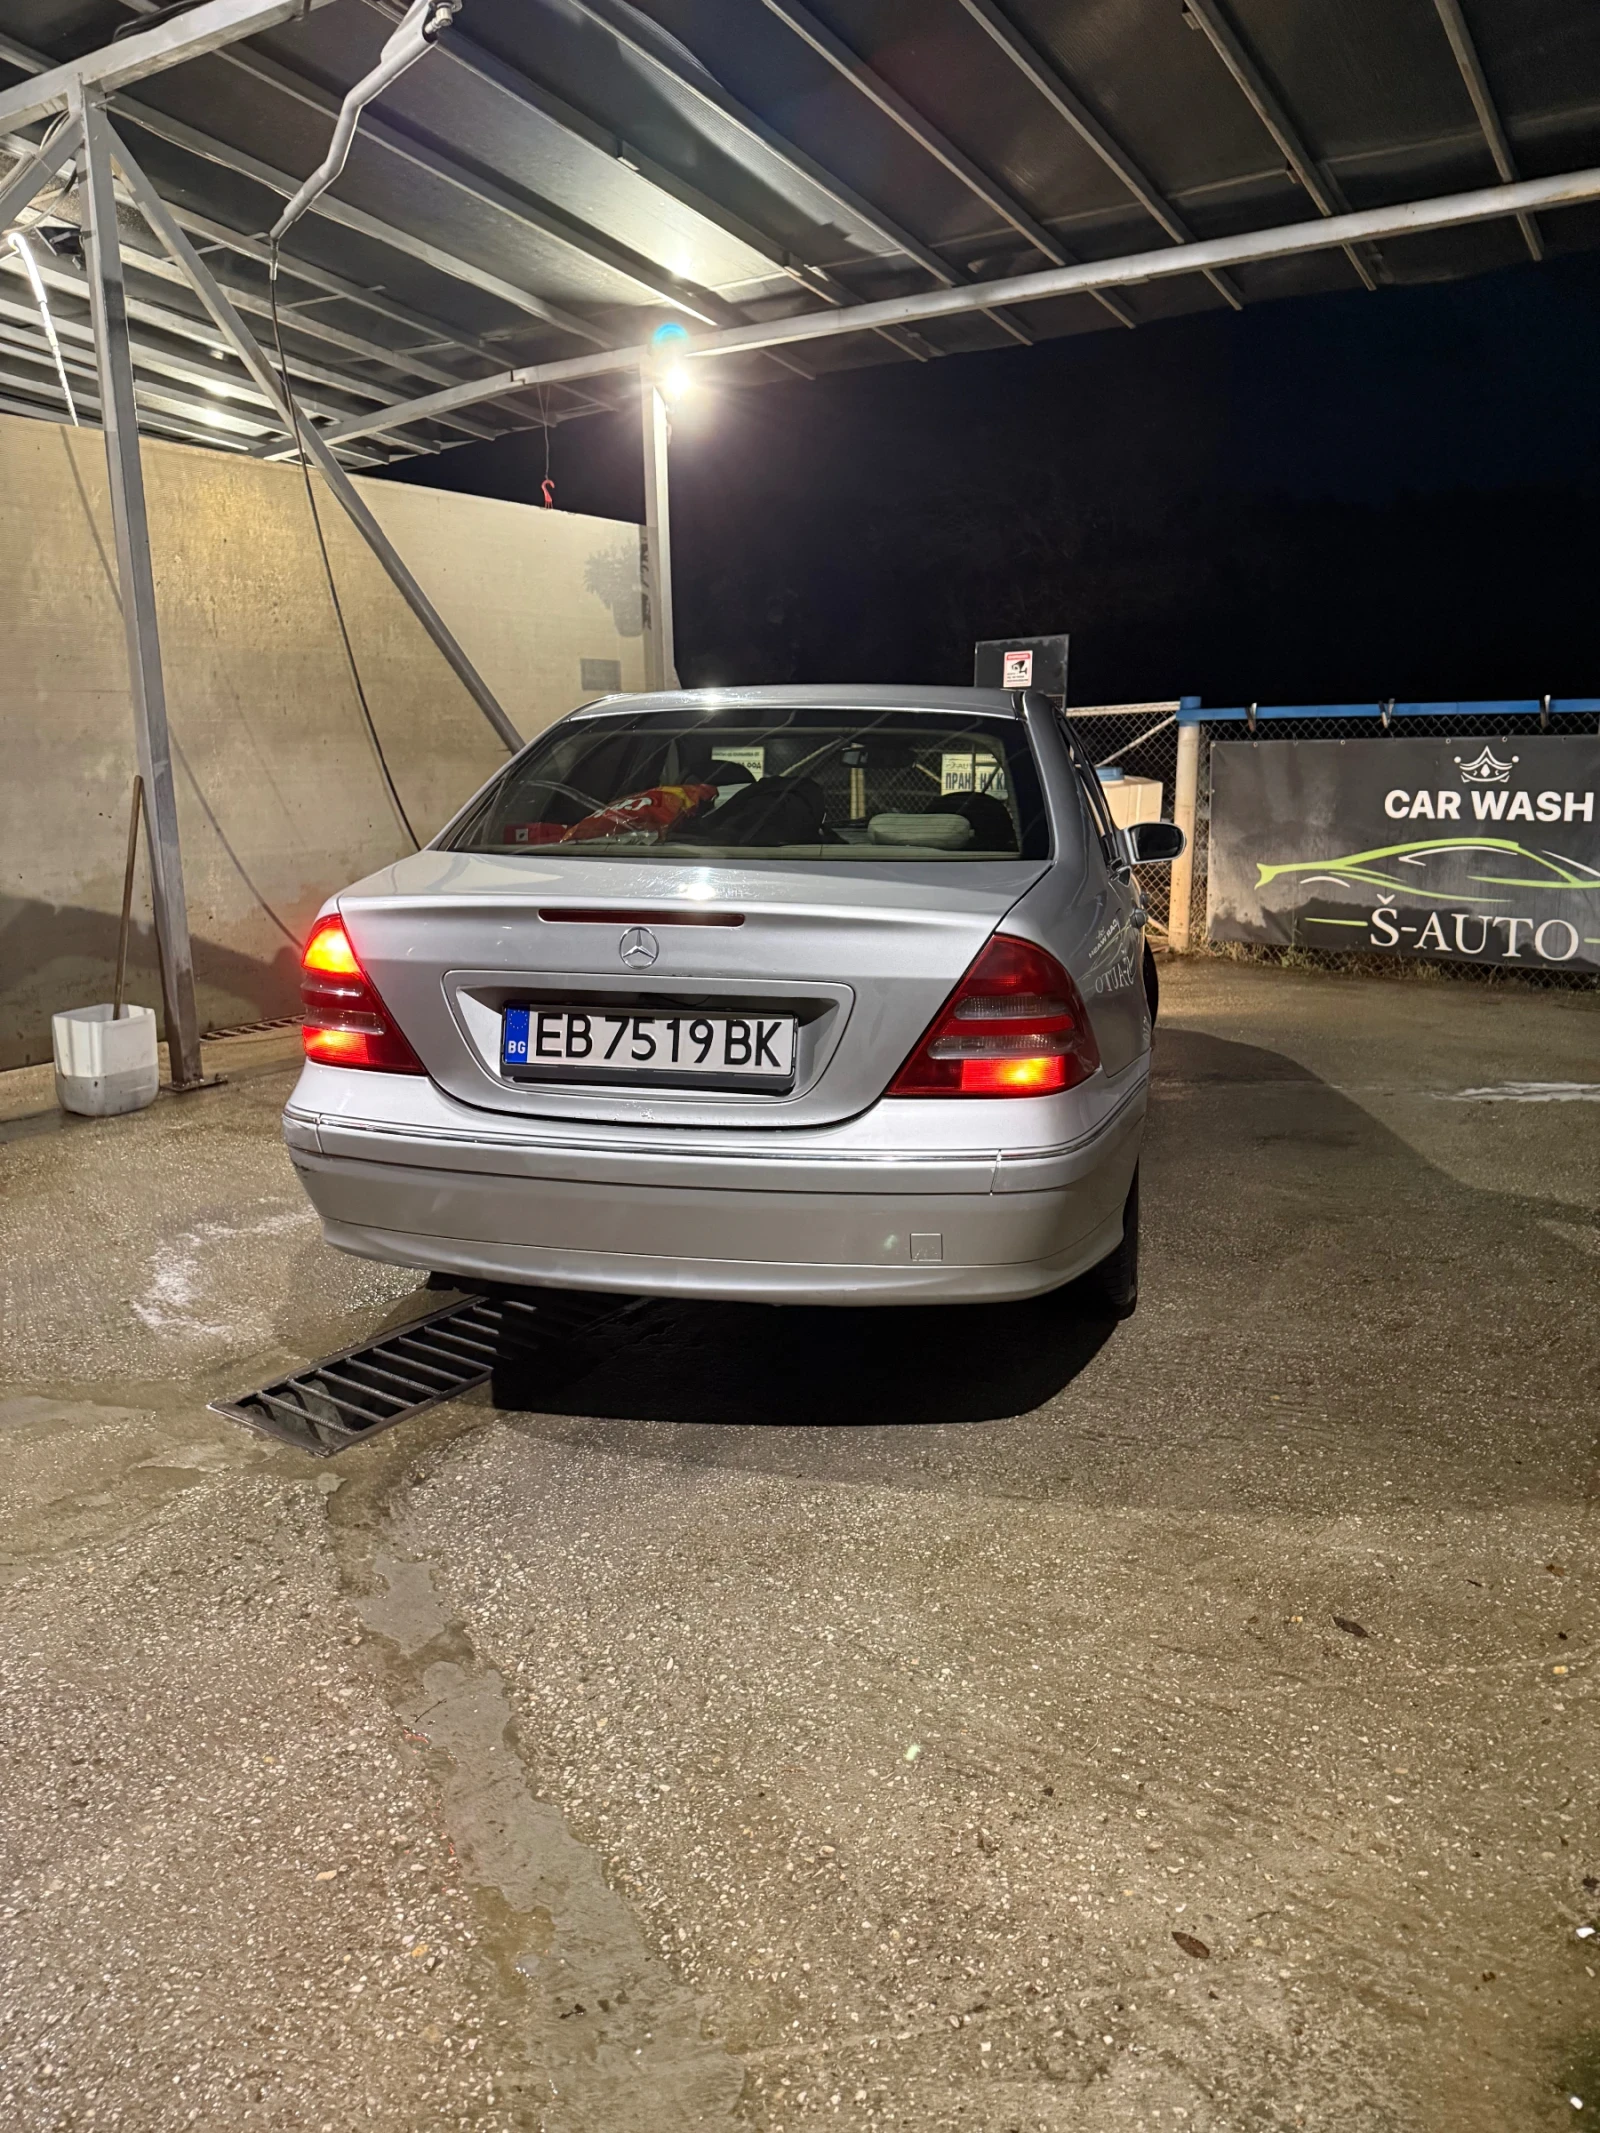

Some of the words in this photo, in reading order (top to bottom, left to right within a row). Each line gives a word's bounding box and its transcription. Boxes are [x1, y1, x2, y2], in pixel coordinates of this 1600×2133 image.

[945, 772, 976, 790] ПРАН
[1384, 789, 1461, 820] CAR
[1471, 790, 1595, 822] WASH
[1370, 893, 1580, 961] Š-AUTO
[507, 1040, 526, 1054] BG
